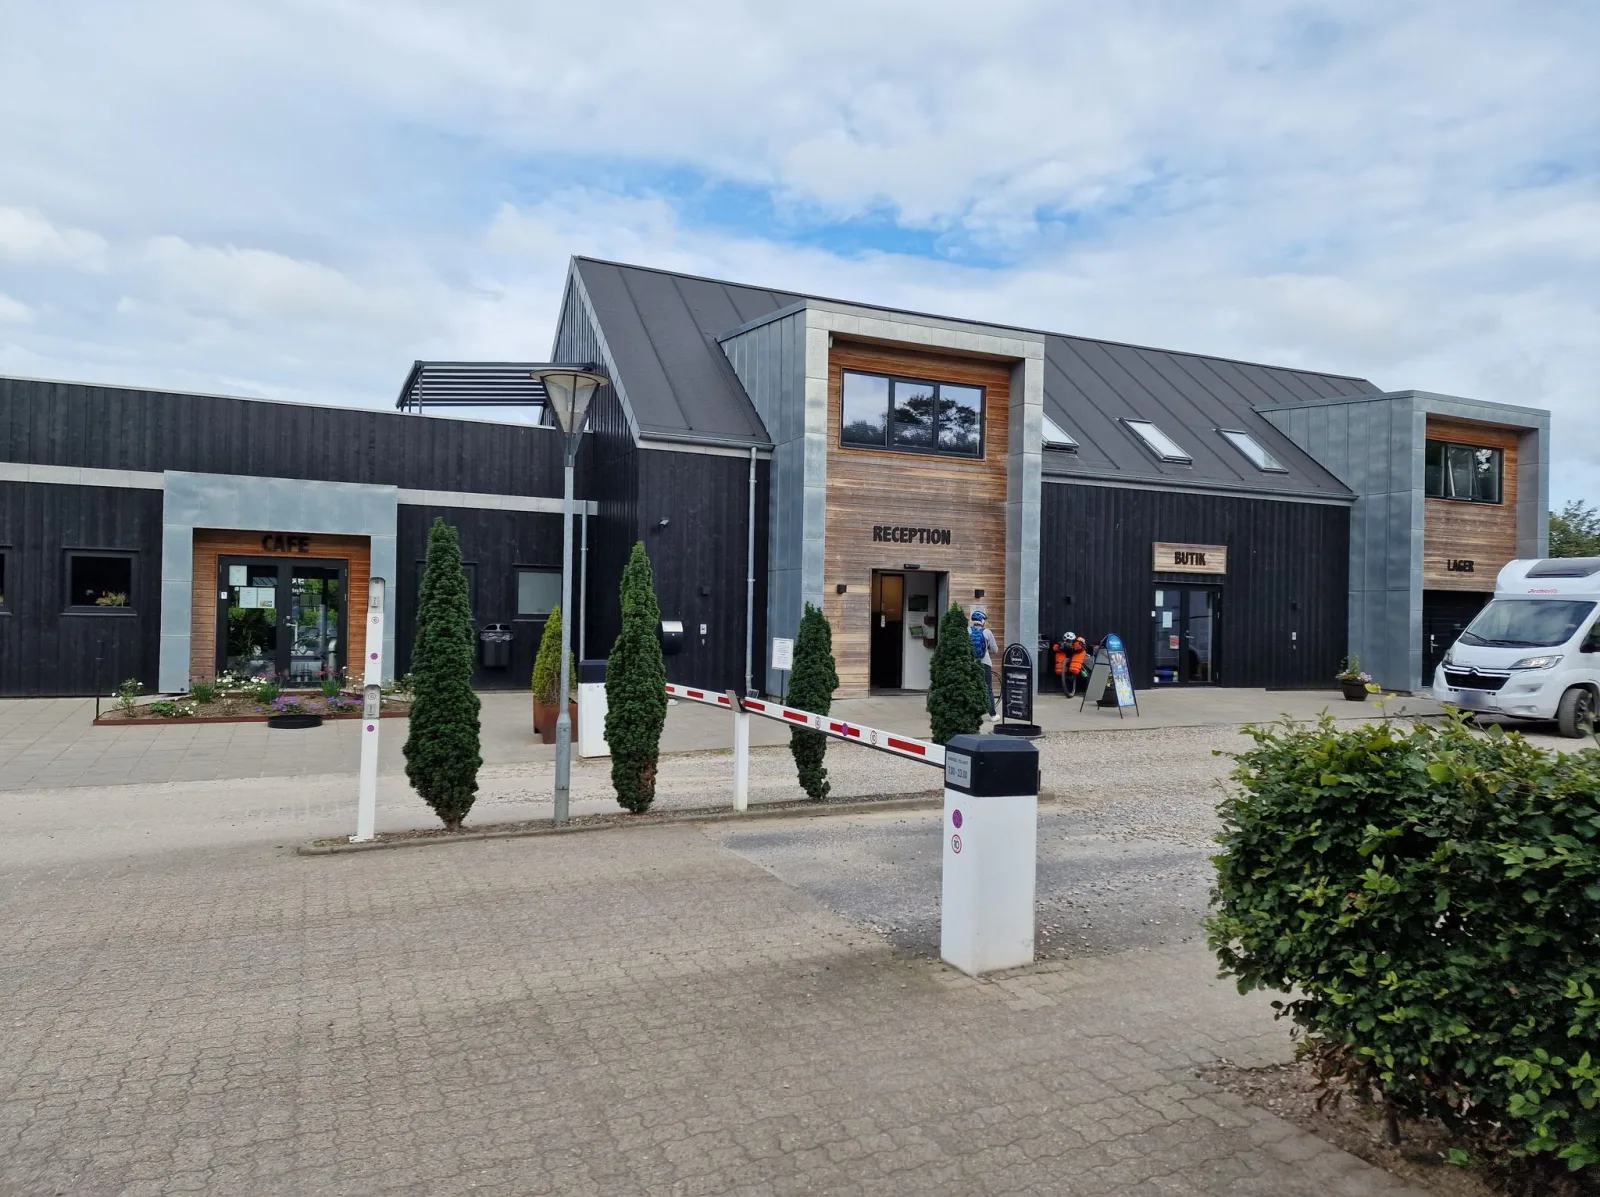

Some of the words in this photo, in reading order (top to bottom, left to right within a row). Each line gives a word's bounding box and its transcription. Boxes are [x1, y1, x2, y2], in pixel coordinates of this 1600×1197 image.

[261, 534, 310, 553] CAFE
[873, 525, 951, 545] RECEPTION
[1174, 551, 1206, 566] BUTIK
[1447, 559, 1475, 573] LAGER
